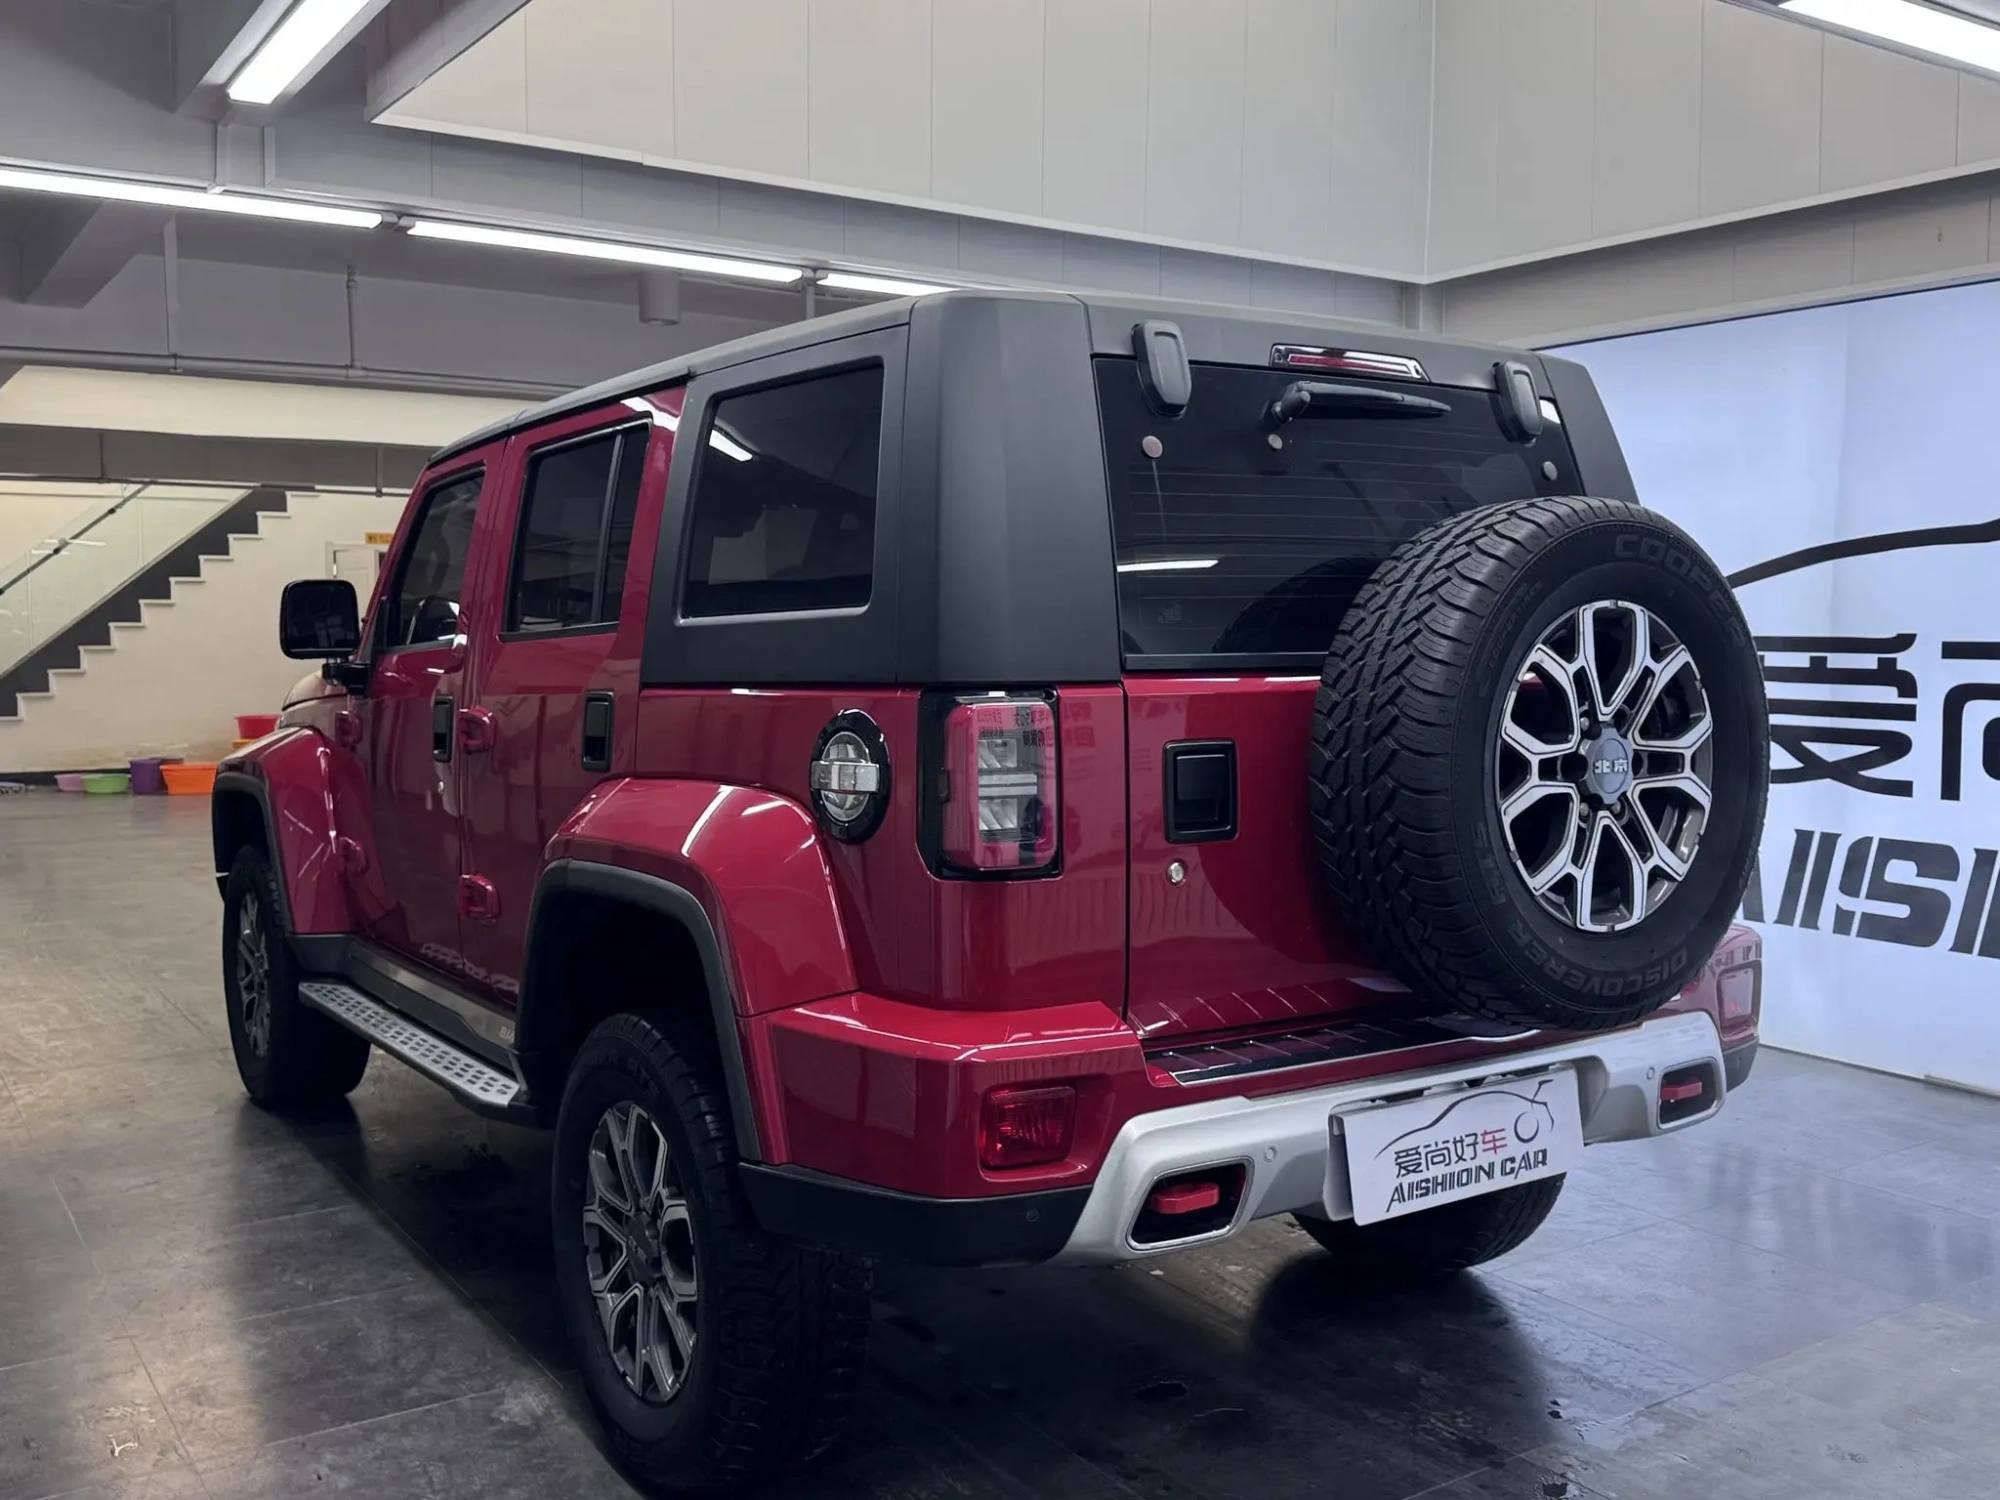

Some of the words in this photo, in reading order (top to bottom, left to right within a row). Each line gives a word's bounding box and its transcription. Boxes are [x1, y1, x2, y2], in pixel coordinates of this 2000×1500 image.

[1615, 534, 1746, 646] COOPER
[1594, 758, 1628, 774] 北京
[1741, 828, 2000, 960] IS
[1508, 919, 1688, 997] DISCOVERER
[1386, 1162, 1494, 1213] AISHION
[1501, 1148, 1548, 1180] CAR
[1394, 1128, 1508, 1178] 爱尚好车
